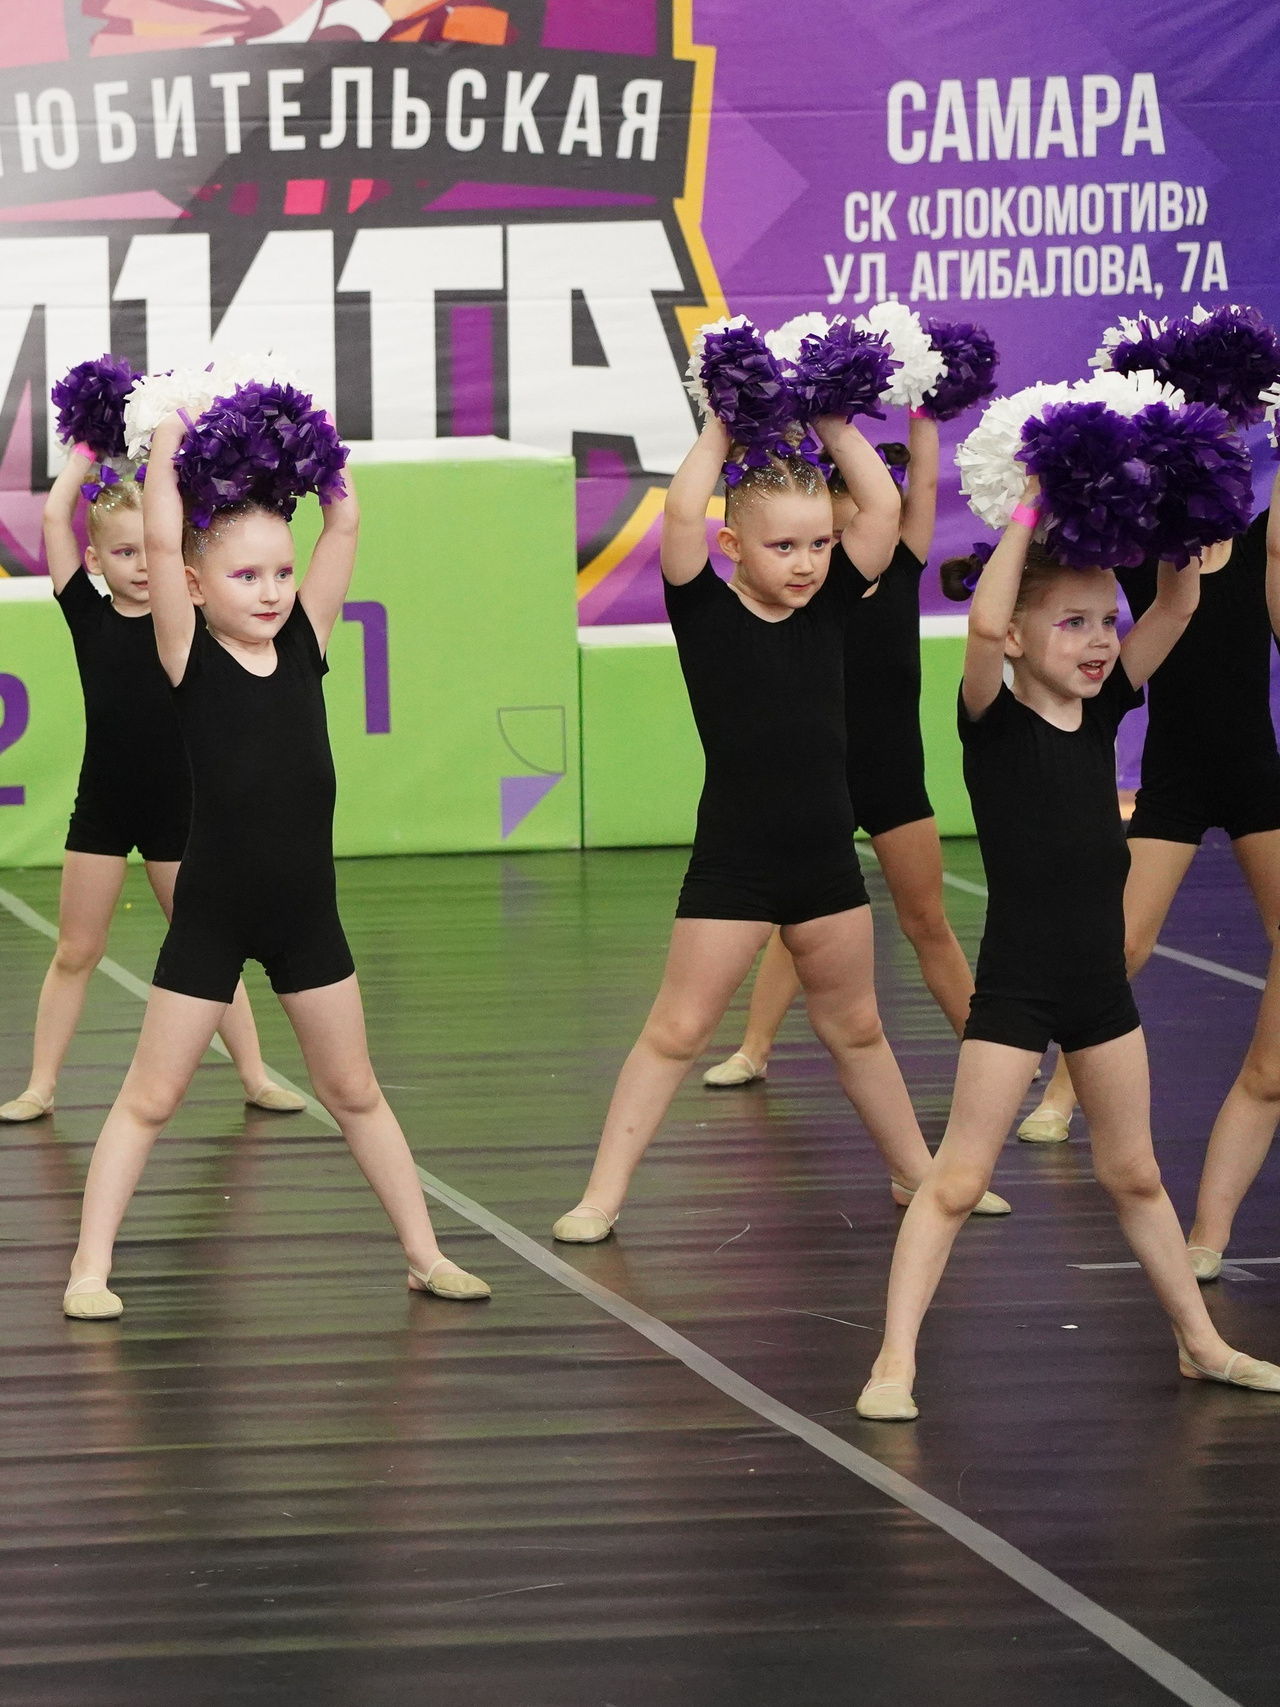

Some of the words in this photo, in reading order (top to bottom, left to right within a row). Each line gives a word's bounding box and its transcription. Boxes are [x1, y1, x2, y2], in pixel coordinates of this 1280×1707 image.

[887, 72, 1167, 165] САМАРА
[844, 191, 897, 243] СК
[907, 180, 1209, 240] «ЛОКОМОТИВ»
[824, 252, 899, 305] УЛ.
[909, 243, 1164, 301] АГИБАЛОВА,
[1176, 240, 1229, 292] 7А
[342, 600, 391, 735] 1
